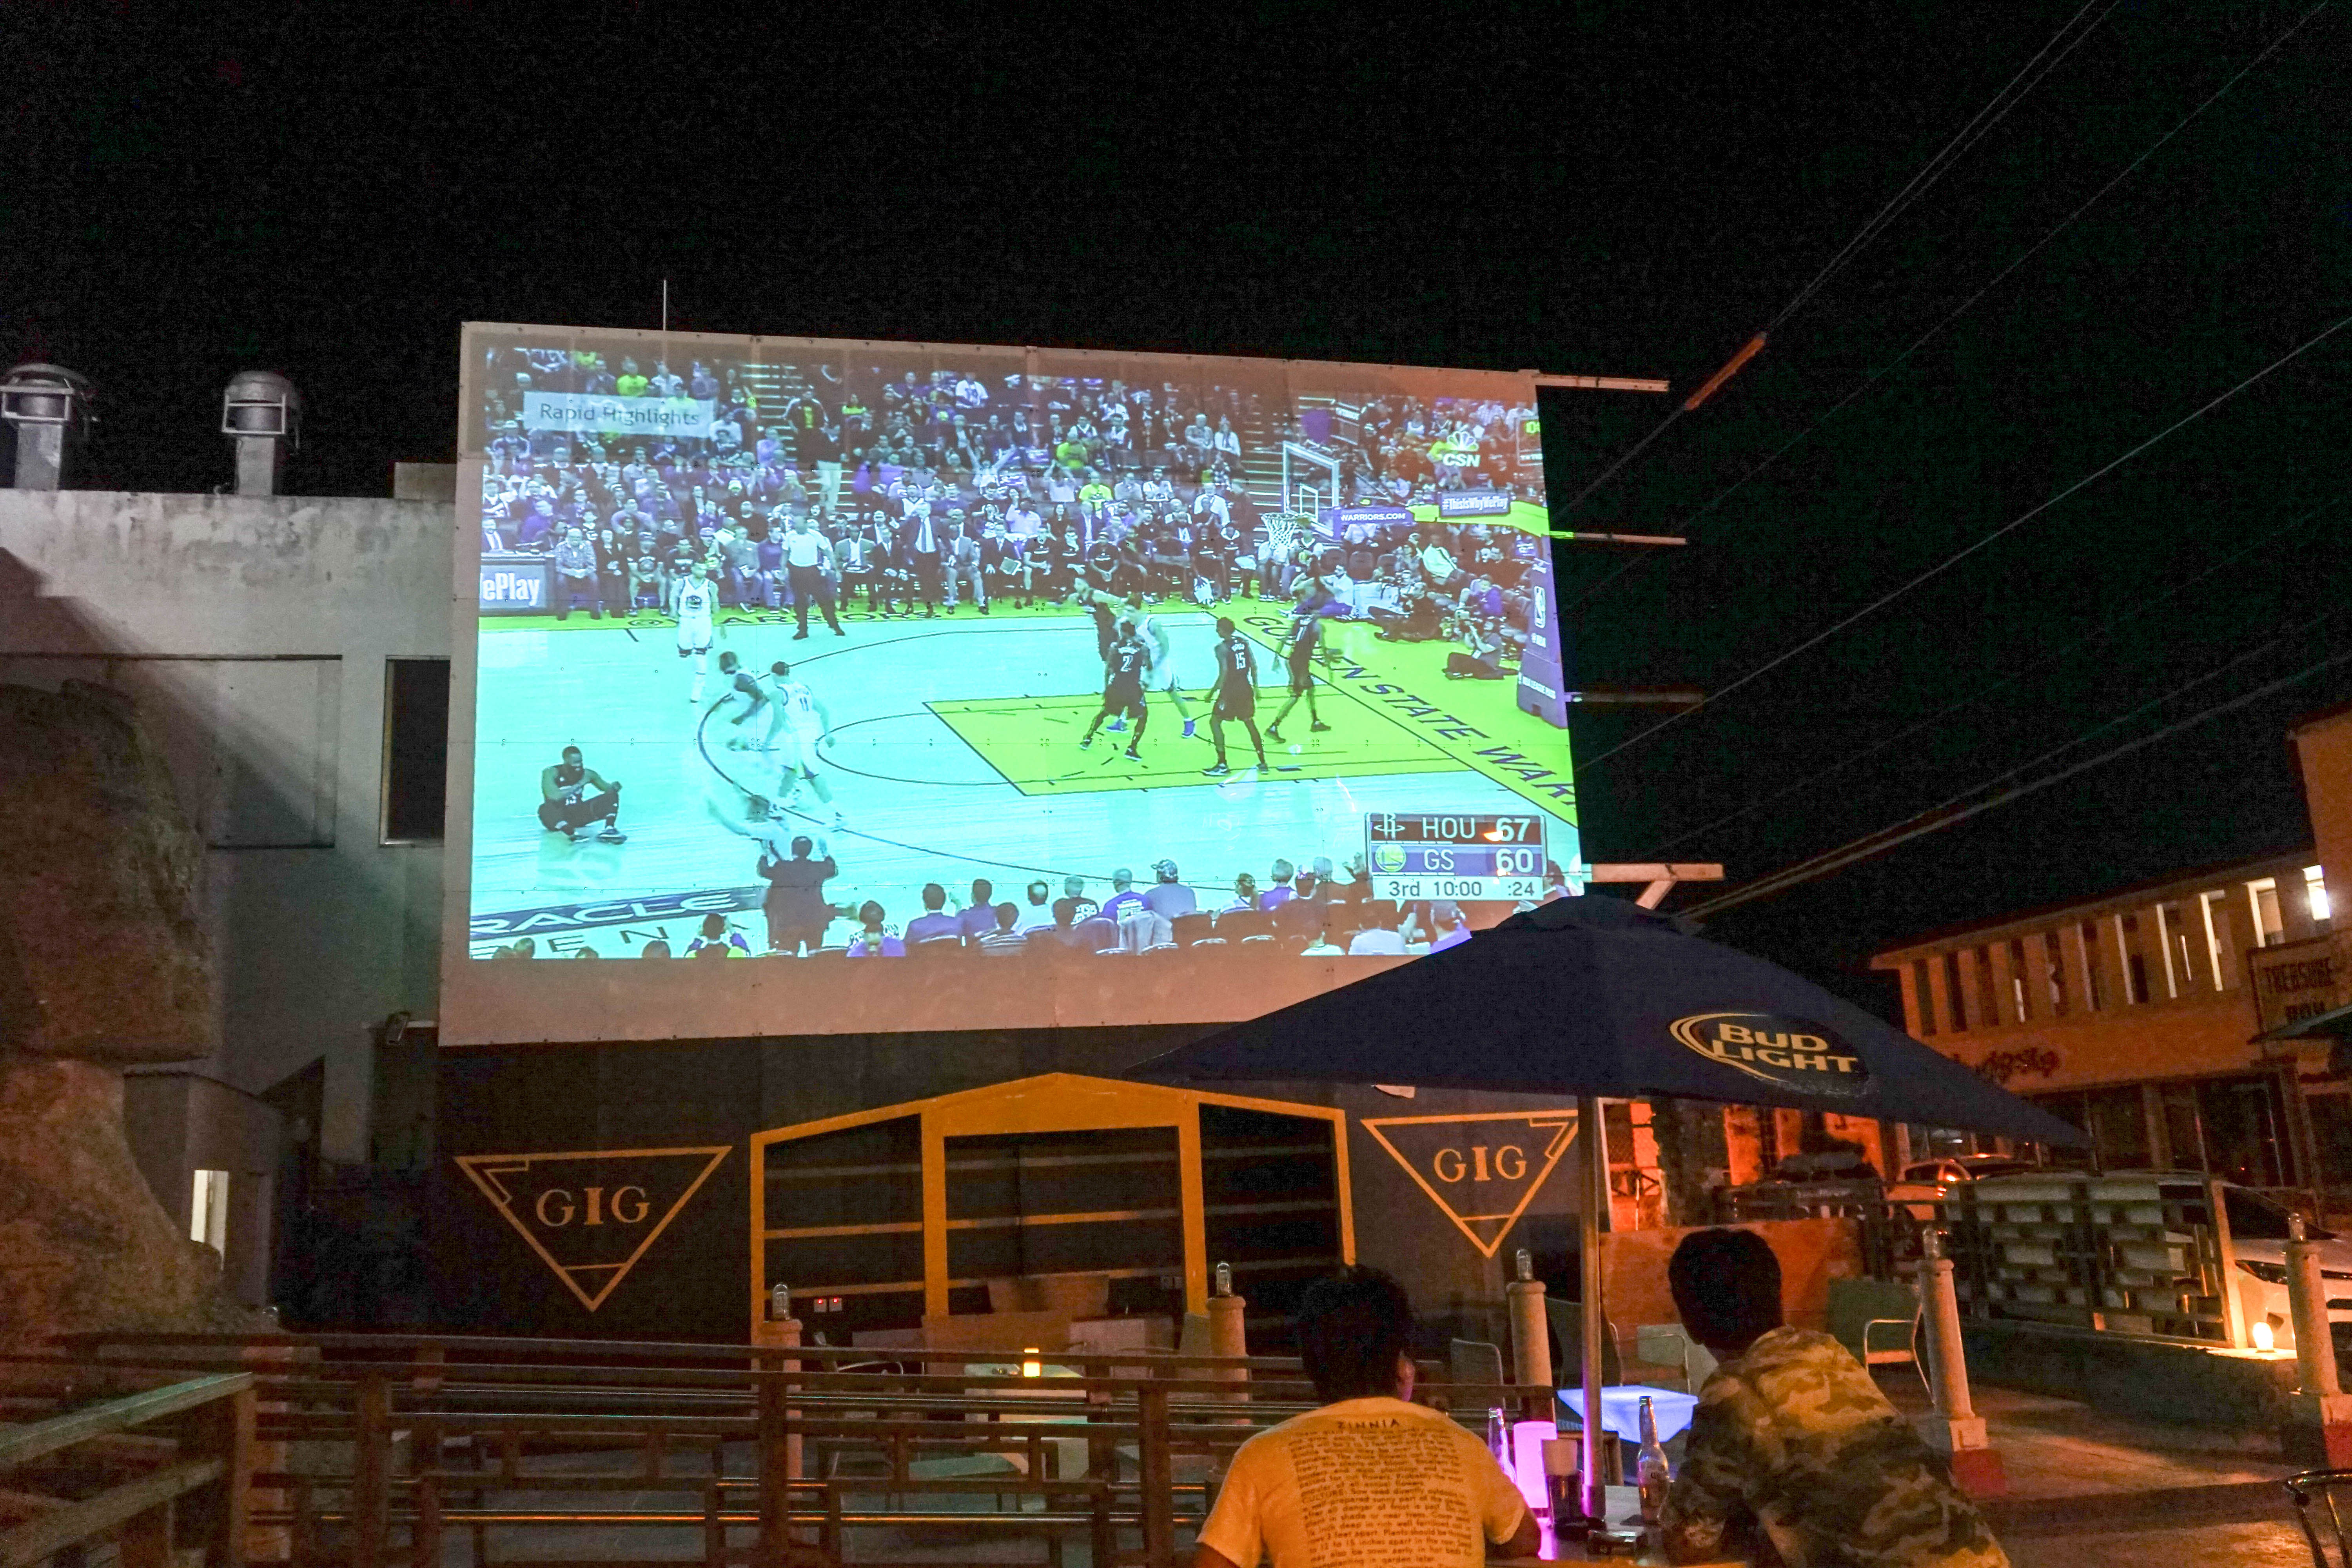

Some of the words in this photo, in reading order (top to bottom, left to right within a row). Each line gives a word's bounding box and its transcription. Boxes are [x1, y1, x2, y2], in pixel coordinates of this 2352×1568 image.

[541, 403, 595, 427] Rapid
[604, 405, 700, 427] Highlights
[1443, 453, 1481, 467] CSN
[480, 572, 540, 606] ePlay
[1235, 652, 1246, 670] 15
[1359, 684, 1491, 741] STATE
[1472, 746, 1575, 805] WAR
[1422, 817, 1476, 839] HOU
[1495, 818, 1530, 841] 67
[1424, 849, 1455, 871] GS
[1496, 849, 1534, 873] 60
[1389, 881, 1420, 897] 3rd
[1434, 882, 1482, 896] 10:00
[1508, 882, 1534, 896] :24
[1719, 1023, 1828, 1052] BUD
[1712, 1039, 1858, 1073] LIGHT
[1434, 1145, 1528, 1183] GIG
[535, 1185, 650, 1227] GIG
[1336, 1418, 1399, 1429] ZINNIA
[1330, 1494, 1369, 1507] prepared
[1373, 1497, 1396, 1506] sunny
[1342, 1504, 1372, 1513] danger
[1340, 1512, 1367, 1521] shade
[1339, 1522, 1362, 1530] deep
[1410, 1527, 1436, 1536] should
[1388, 1538, 1411, 1546] apart
[1381, 1555, 1411, 1564] garden
